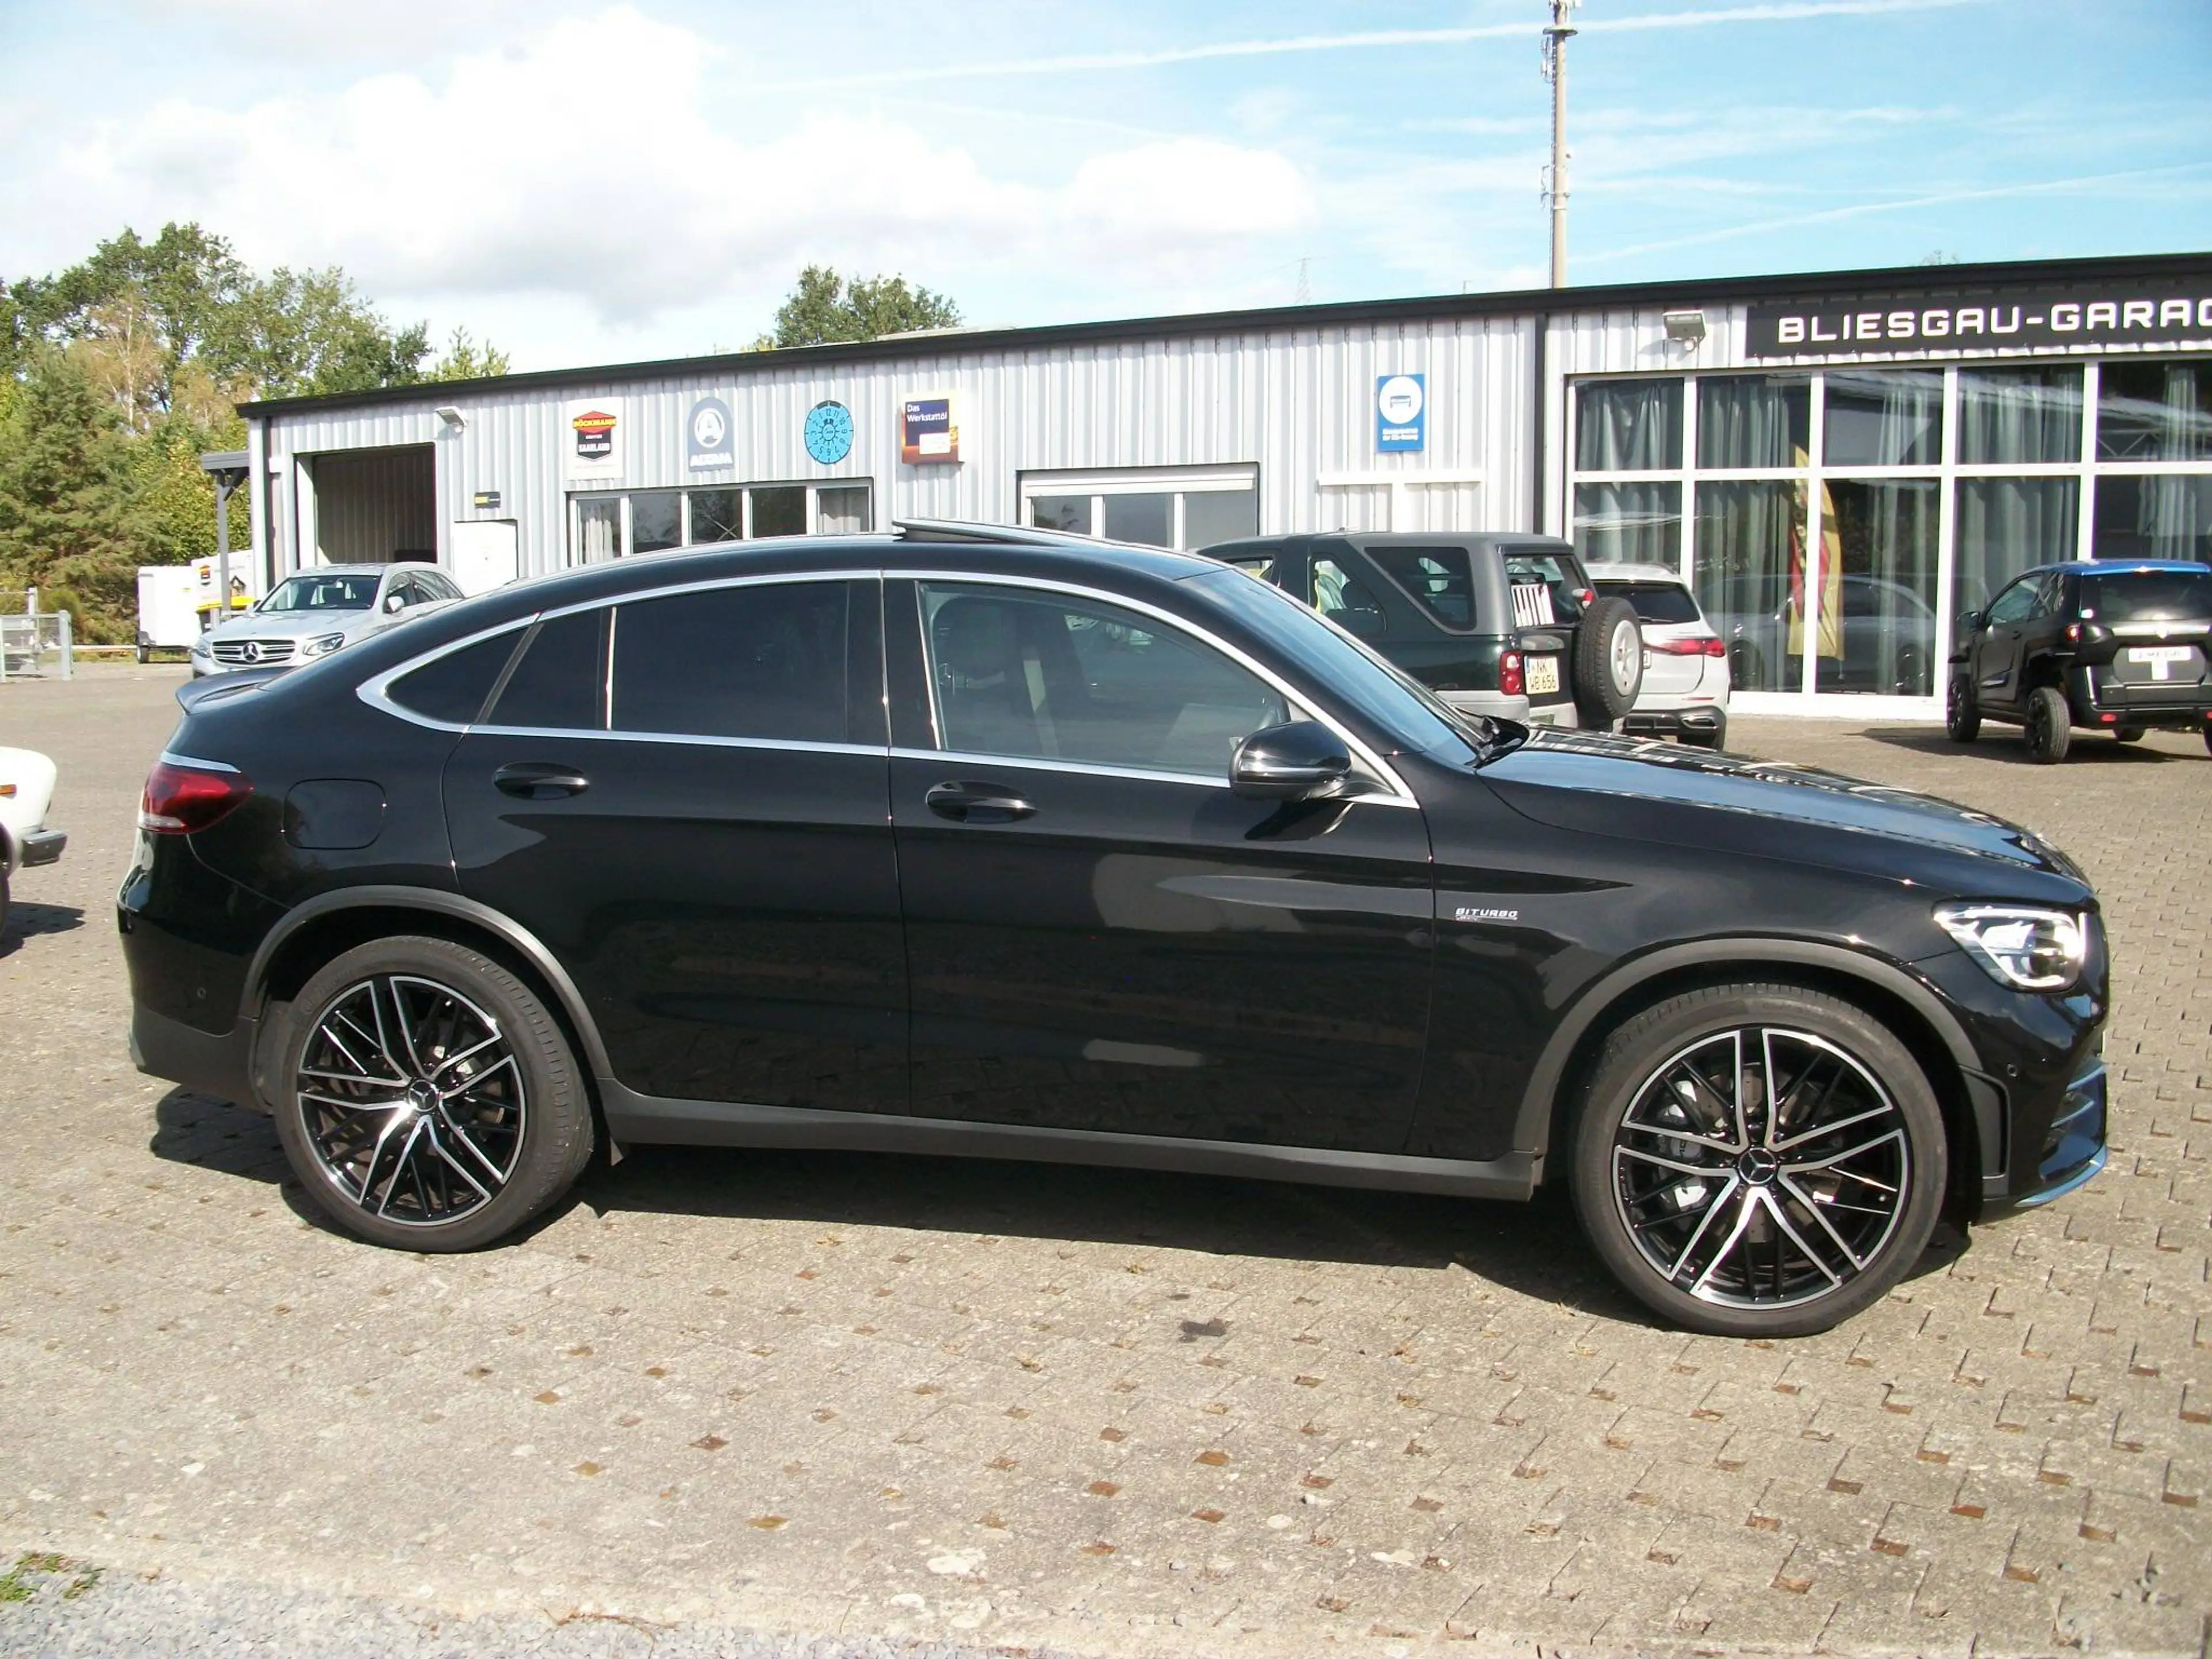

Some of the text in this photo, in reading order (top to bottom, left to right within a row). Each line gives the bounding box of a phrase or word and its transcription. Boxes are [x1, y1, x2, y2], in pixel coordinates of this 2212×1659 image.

[825, 408, 831, 416] 12
[907, 404, 920, 412] Das
[907, 411, 948, 422] Werkstattöl
[1536, 660, 1548, 673] NK
[1455, 907, 1518, 918] BITURBO
